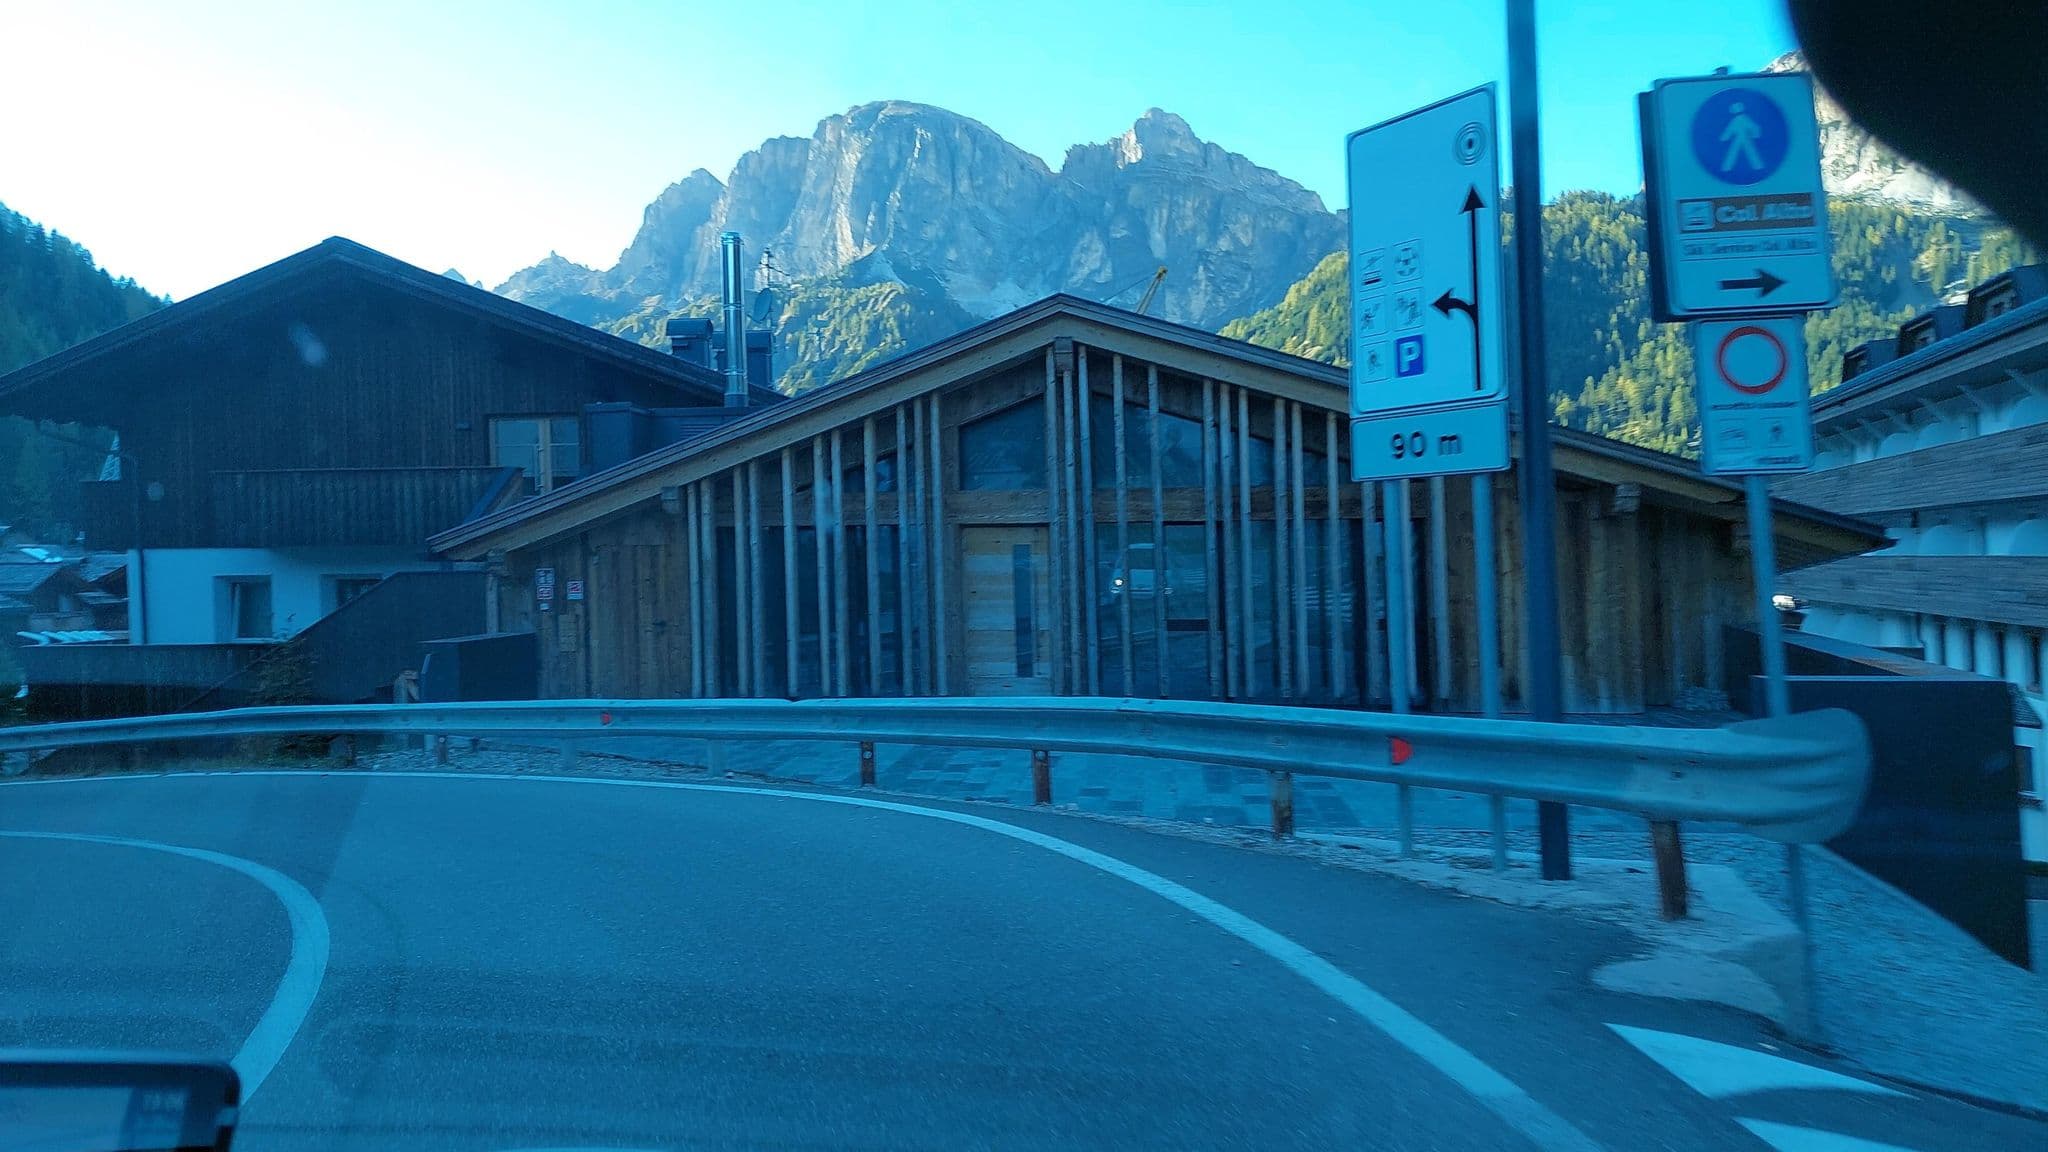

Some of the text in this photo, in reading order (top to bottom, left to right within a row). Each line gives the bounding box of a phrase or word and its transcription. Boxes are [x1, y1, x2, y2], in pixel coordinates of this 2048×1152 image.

[1716, 204, 1760, 223] Col
[1400, 341, 1420, 372] P
[1392, 431, 1463, 459] 90 m
